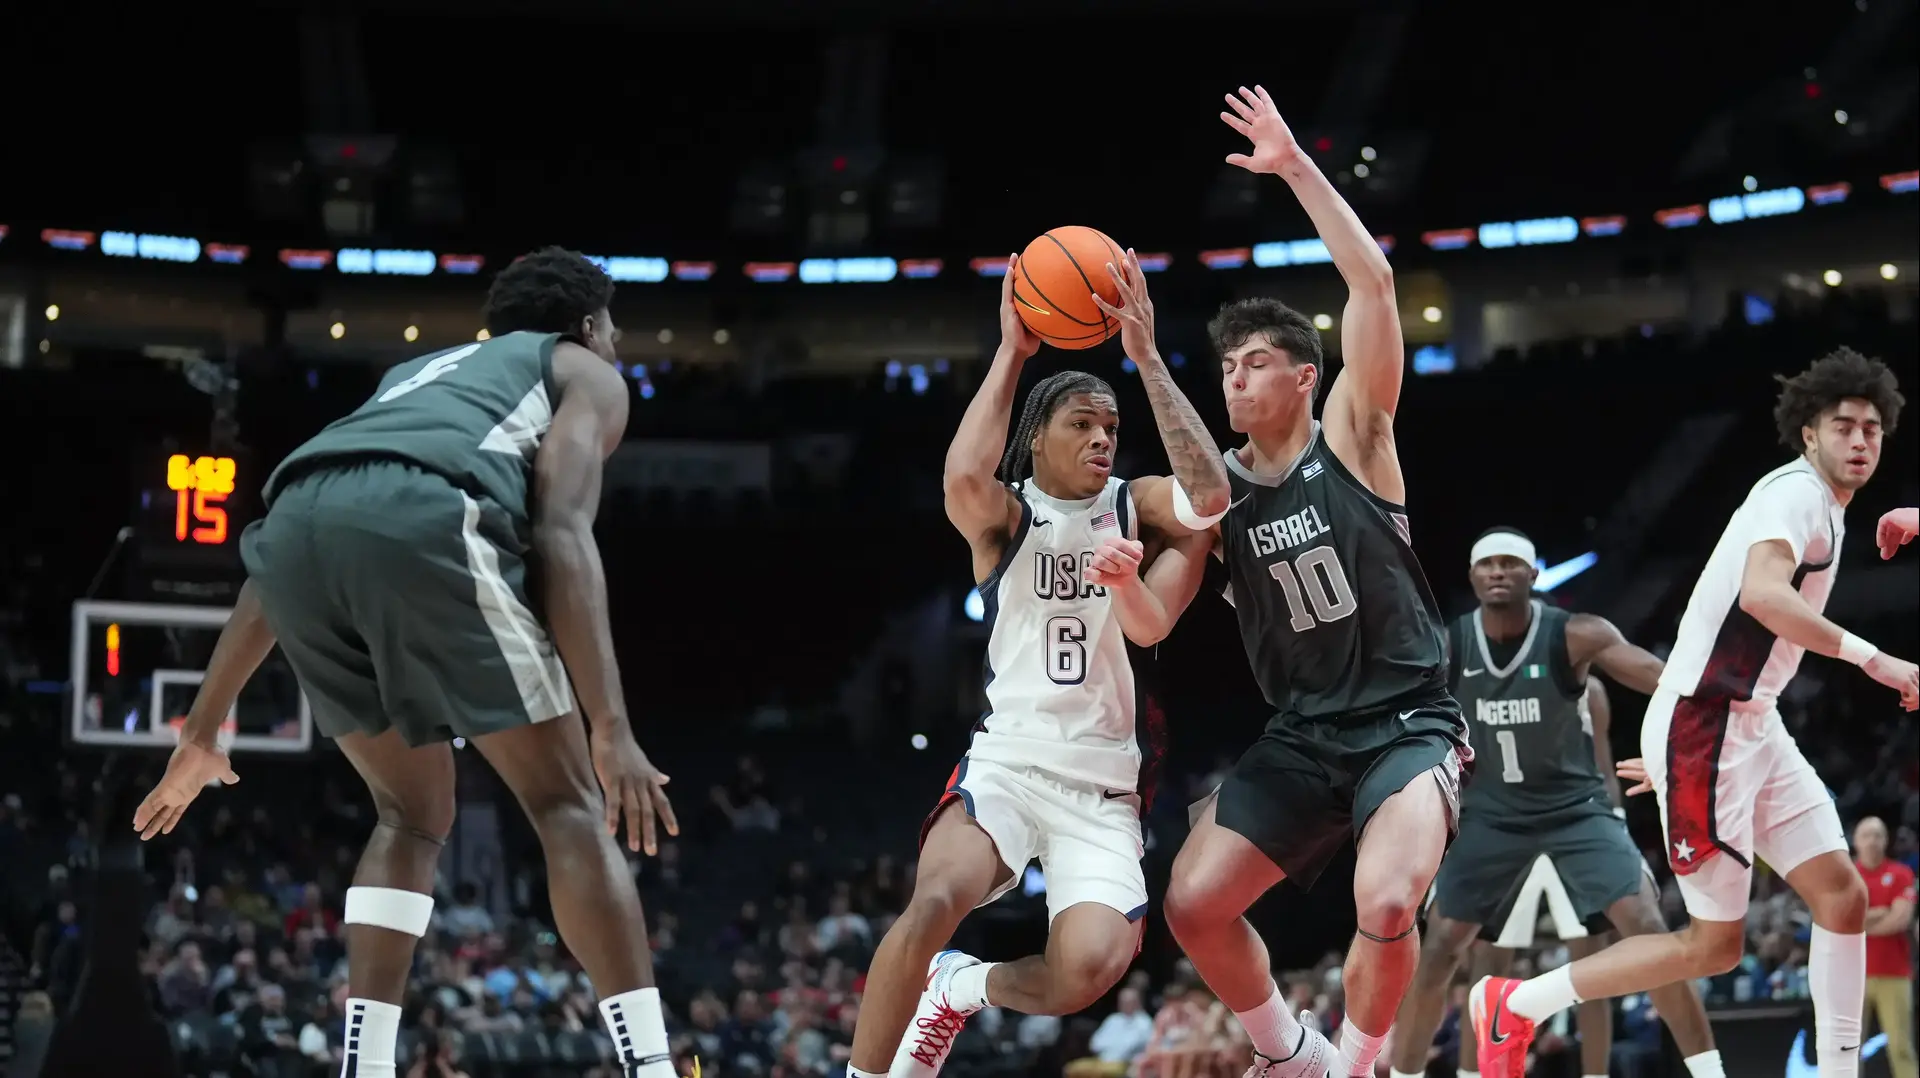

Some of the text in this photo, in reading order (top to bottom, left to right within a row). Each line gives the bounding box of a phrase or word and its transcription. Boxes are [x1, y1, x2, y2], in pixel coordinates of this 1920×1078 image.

[175, 489, 228, 545] 15
[1247, 504, 1331, 558] ISRAEL
[1033, 551, 1107, 600] USA
[1268, 545, 1358, 633] 10
[1046, 616, 1087, 686] 6
[1475, 697, 1541, 726] NGERIA
[1496, 730, 1524, 783] 1
